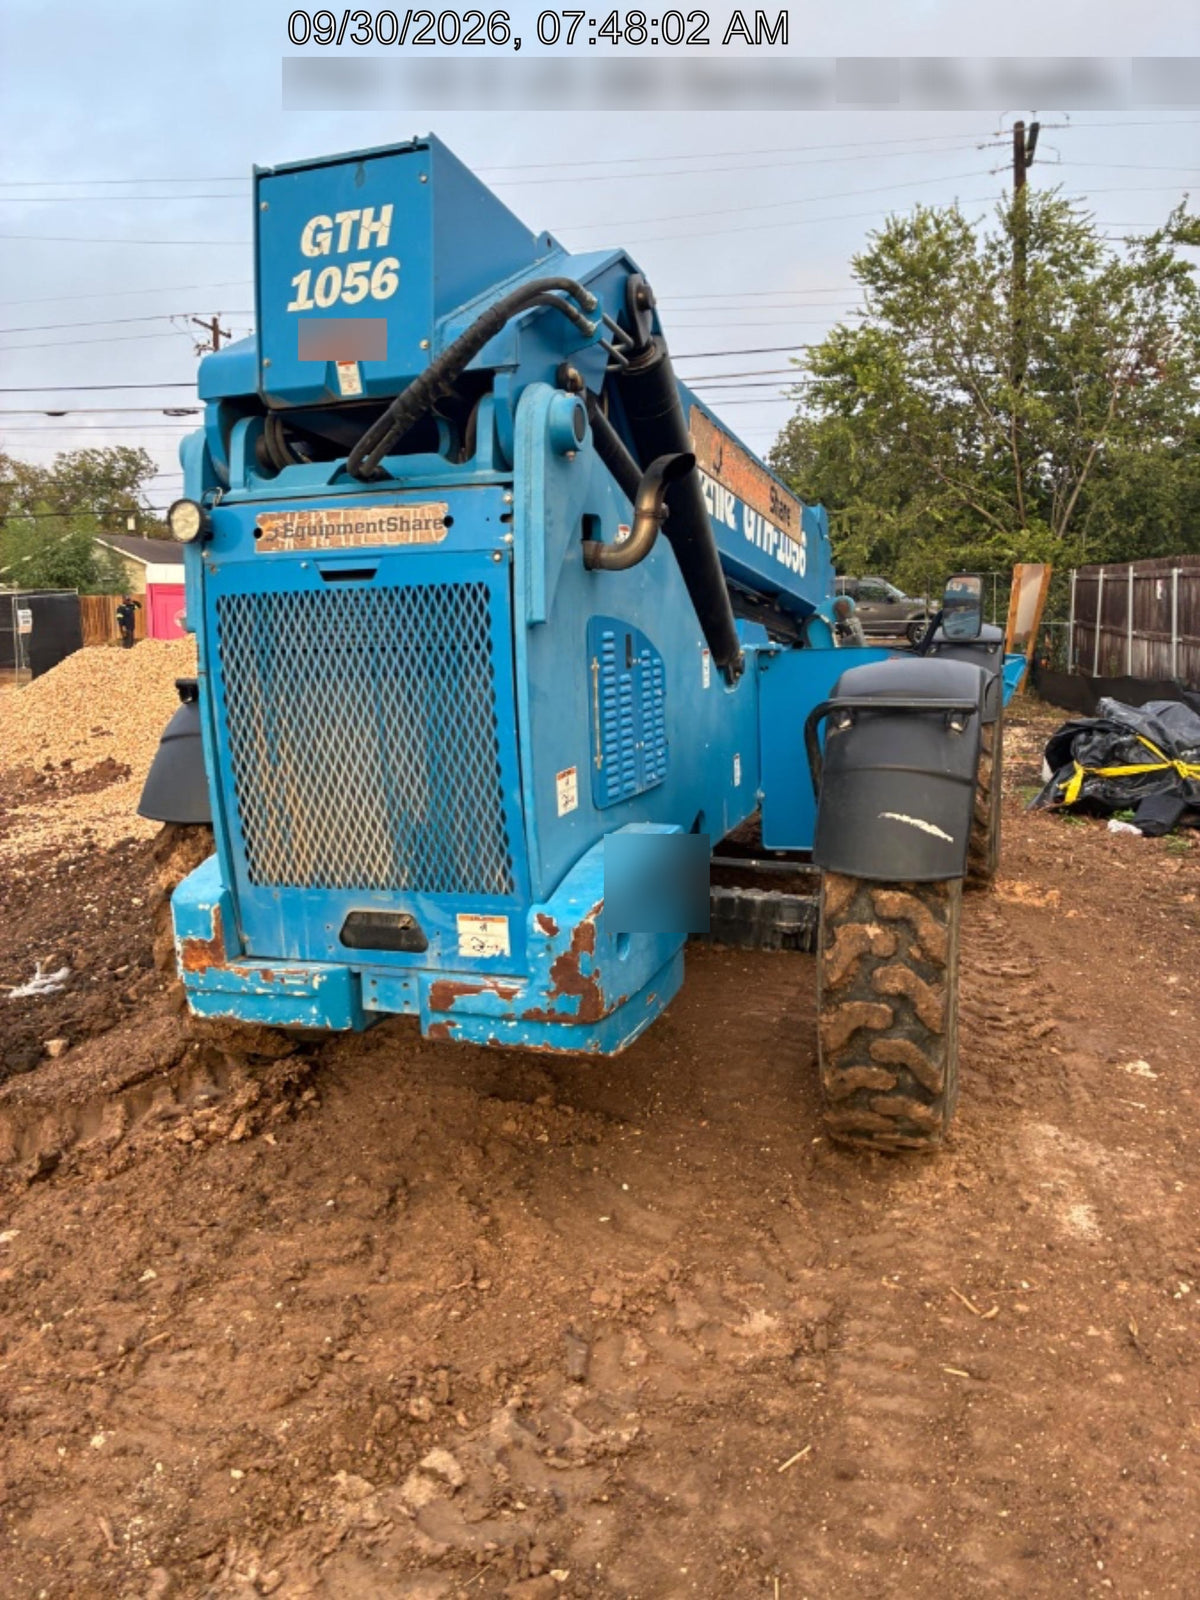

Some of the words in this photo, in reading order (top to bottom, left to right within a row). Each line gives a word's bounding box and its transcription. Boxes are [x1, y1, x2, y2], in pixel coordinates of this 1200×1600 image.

[301, 204, 394, 257] GTH
[286, 257, 401, 312] 1056
[284, 516, 444, 541] EquipmentShare
